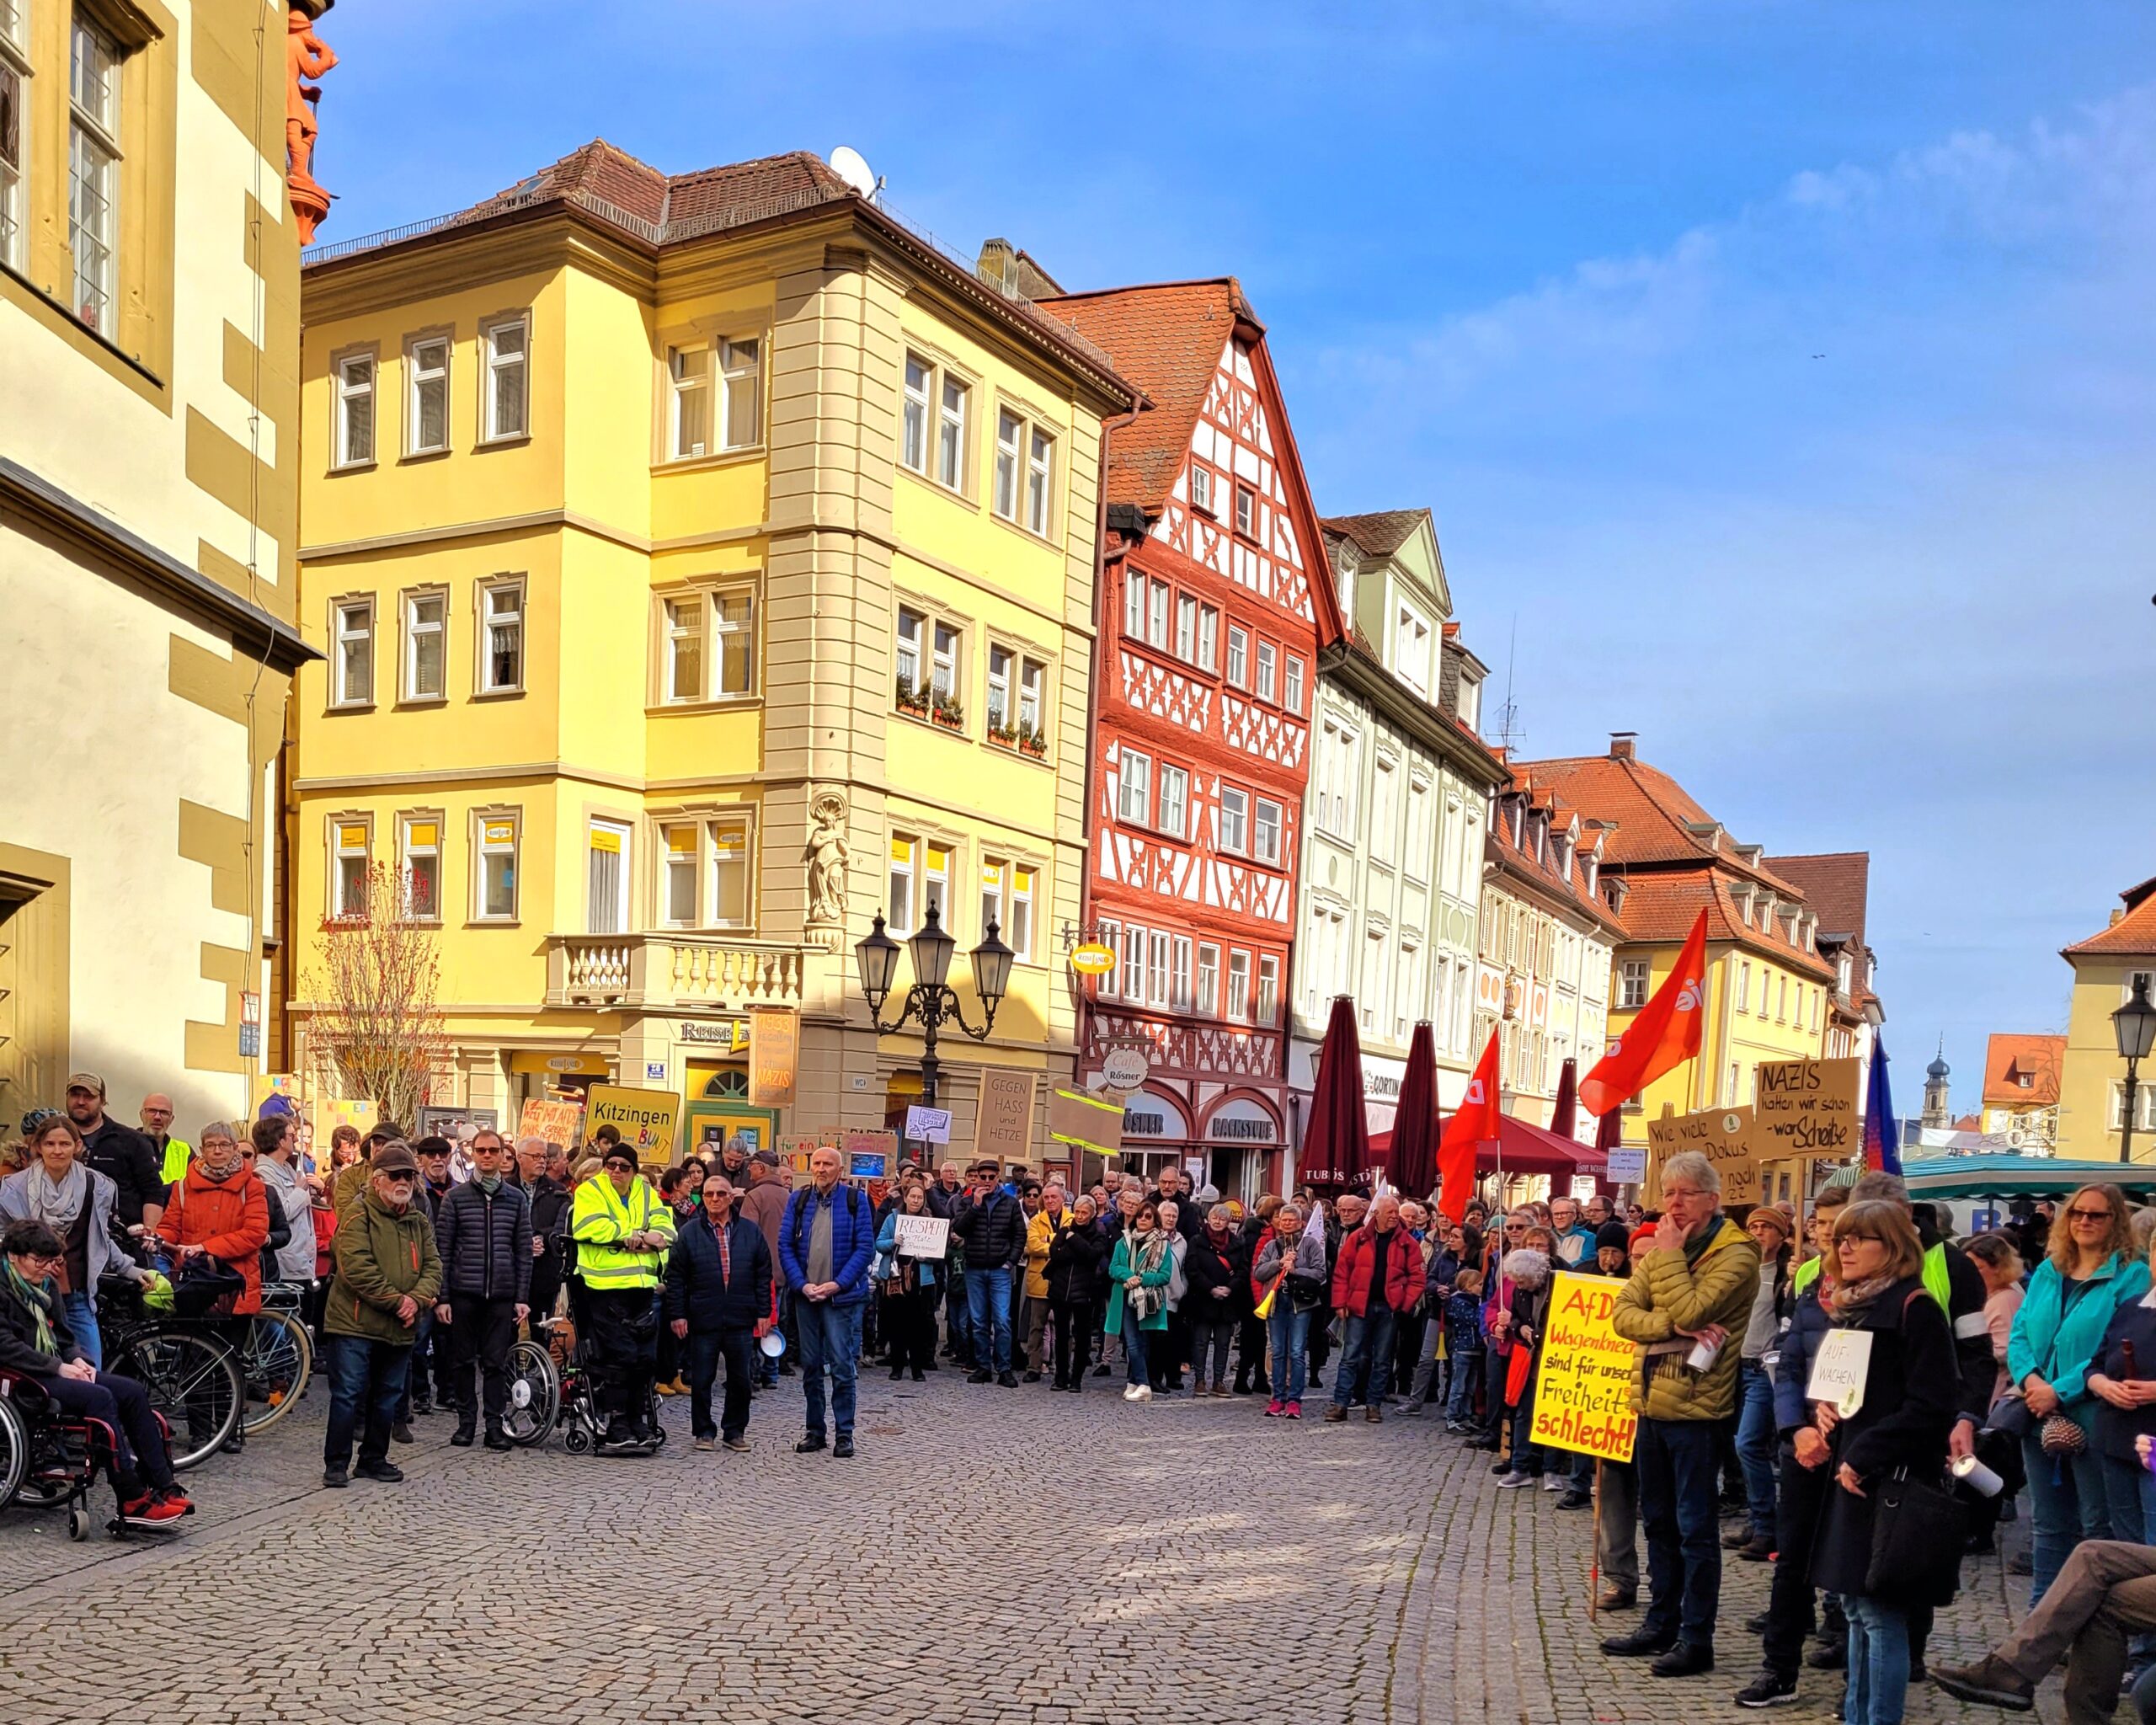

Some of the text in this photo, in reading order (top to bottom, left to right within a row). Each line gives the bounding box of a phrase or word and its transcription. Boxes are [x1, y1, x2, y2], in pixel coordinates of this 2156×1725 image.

[755, 1069, 790, 1088] NAZIS
[991, 1078, 1027, 1094] GEGEN
[1374, 1076, 1400, 1096] CORTIN
[1762, 1063, 1821, 1092] NAZIS
[995, 1097, 1023, 1114] HASS
[1762, 1095, 1849, 1111] hatten wir schon
[595, 1102, 670, 1127] Kitzingen
[1124, 1108, 1164, 1134] ÖSNER
[990, 1127, 1022, 1141] HETZE
[1213, 1118, 1273, 1140] BACKSTUBE
[1652, 1119, 1708, 1142] Wie viele
[1792, 1115, 1847, 1149] Scheiße
[638, 1129, 670, 1154] BUNT
[781, 1138, 796, 1151] für
[798, 1139, 814, 1151] ein
[1705, 1140, 1748, 1162] Dokus
[781, 1153, 813, 1172] DEUT
[1728, 1166, 1755, 1187] noch
[899, 1220, 948, 1236] RESPEKT
[1561, 1289, 1614, 1327] AfD
[1545, 1354, 1572, 1373] sind
[1576, 1355, 1598, 1380] für
[1819, 1366, 1856, 1386] WACHEN
[1542, 1378, 1625, 1414] Freiheit
[1536, 1408, 1636, 1457] schlecht!
